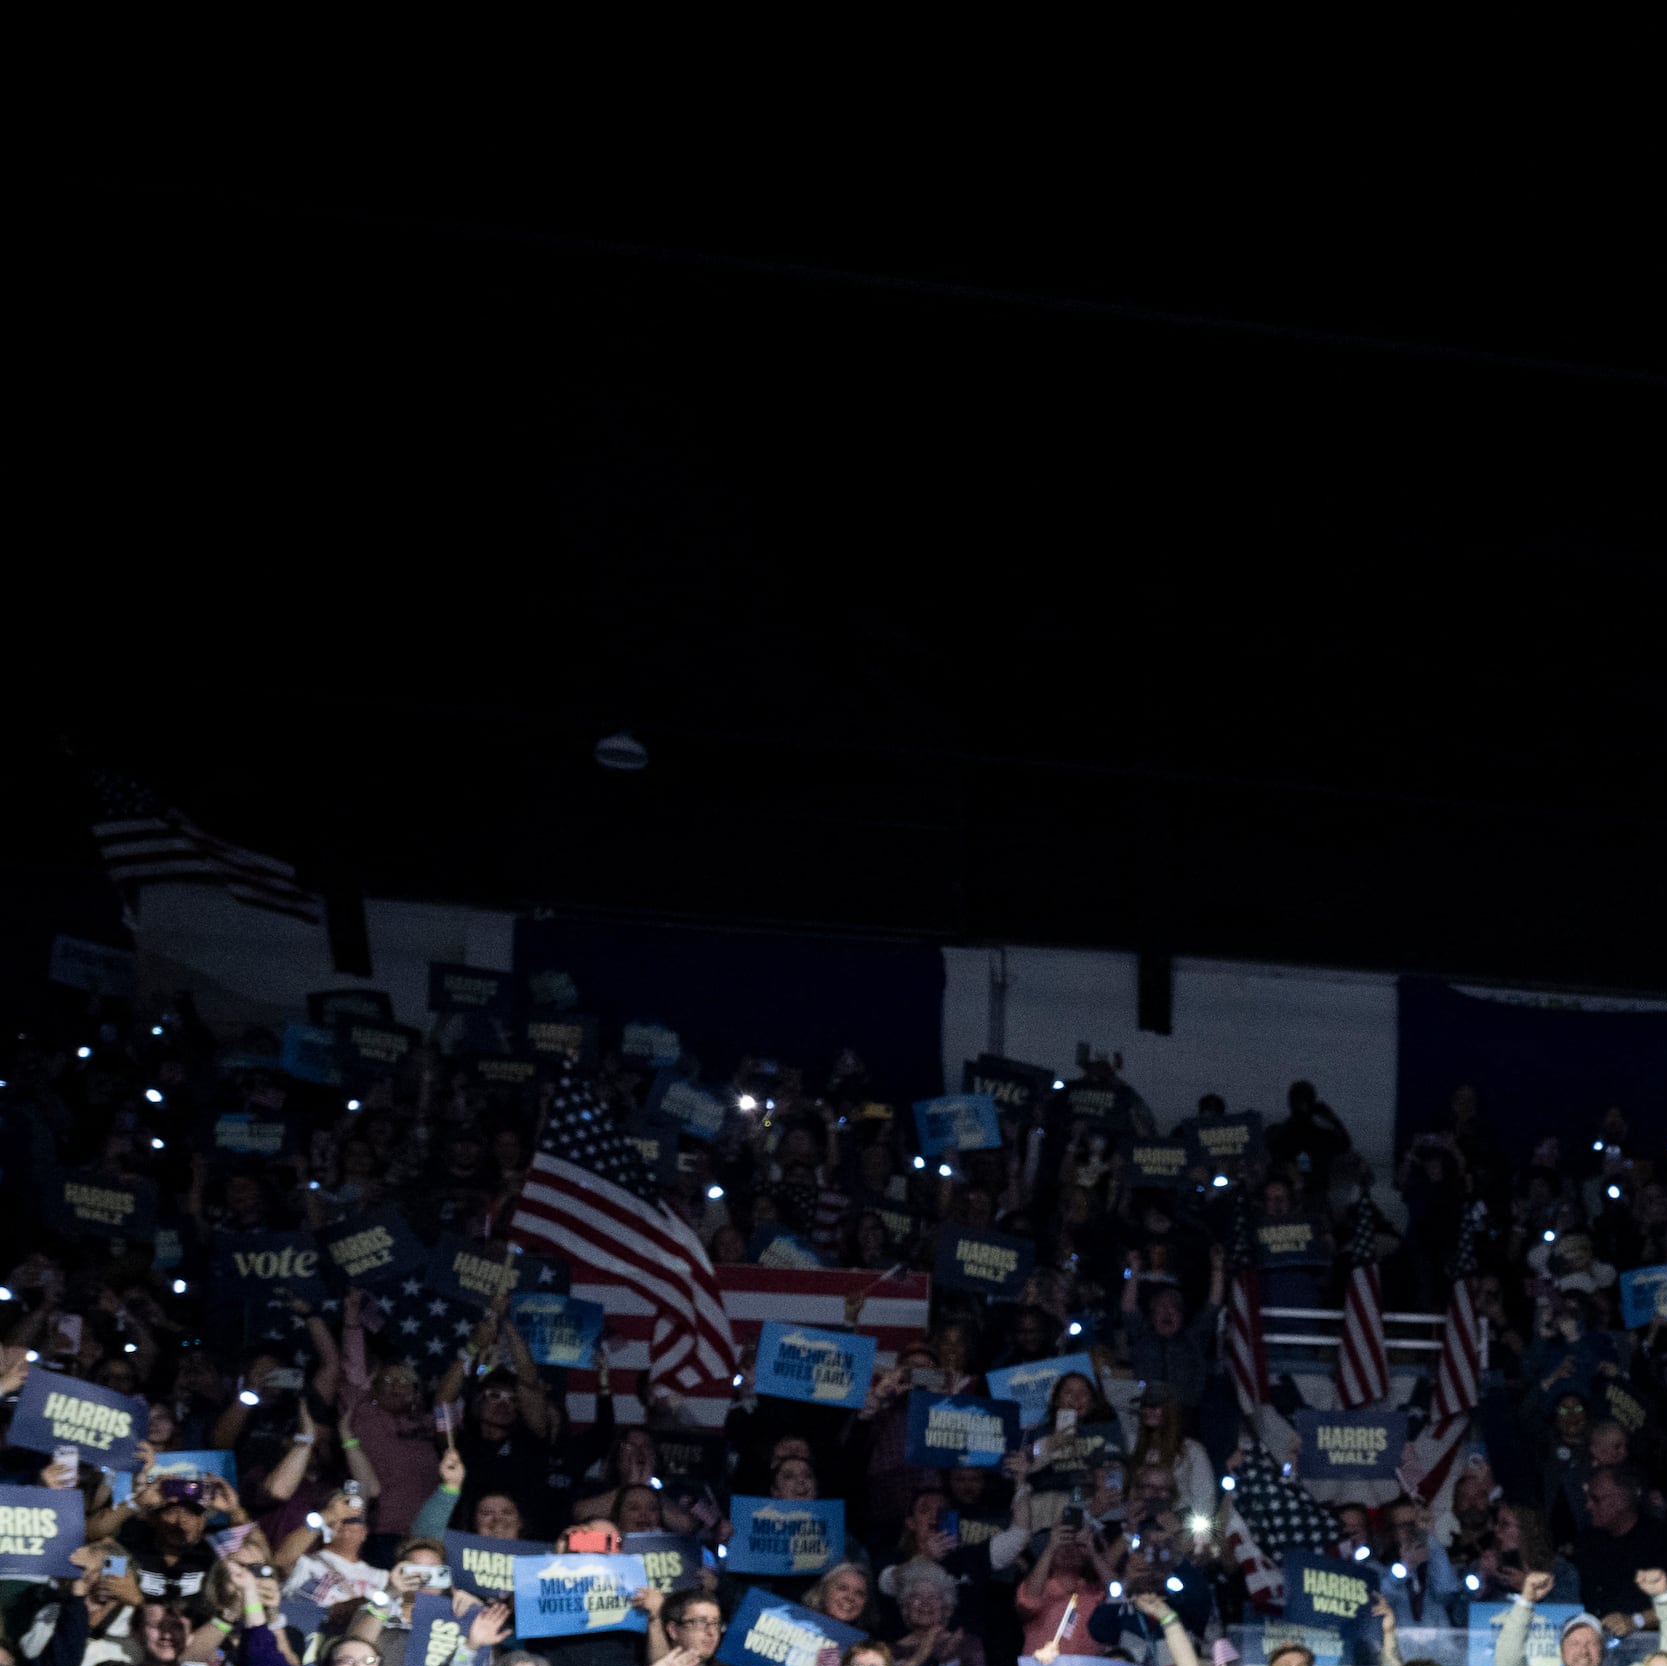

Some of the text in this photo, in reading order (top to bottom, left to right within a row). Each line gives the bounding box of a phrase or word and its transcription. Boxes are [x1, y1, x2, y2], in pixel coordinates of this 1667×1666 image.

[232, 1245, 319, 1279] vote
[778, 1342, 853, 1367] MICHIGAN
[43, 1392, 133, 1439] HARRIS
[52, 1422, 114, 1451] WALZ
[1317, 1425, 1388, 1451] HARRIS
[1329, 1448, 1378, 1466] WALZ
[0, 1505, 58, 1539] RRIS
[752, 1516, 828, 1536] MICHIGAN
[0, 1529, 46, 1556] ALZ
[462, 1549, 514, 1573] HARRI
[646, 1551, 684, 1577] RIS
[474, 1571, 514, 1591] WAL
[539, 1575, 628, 1596] MICHIGAN
[1303, 1567, 1369, 1605] HARRIS
[538, 1594, 633, 1615] VOTES EARLY
[1312, 1595, 1359, 1618] WALZ
